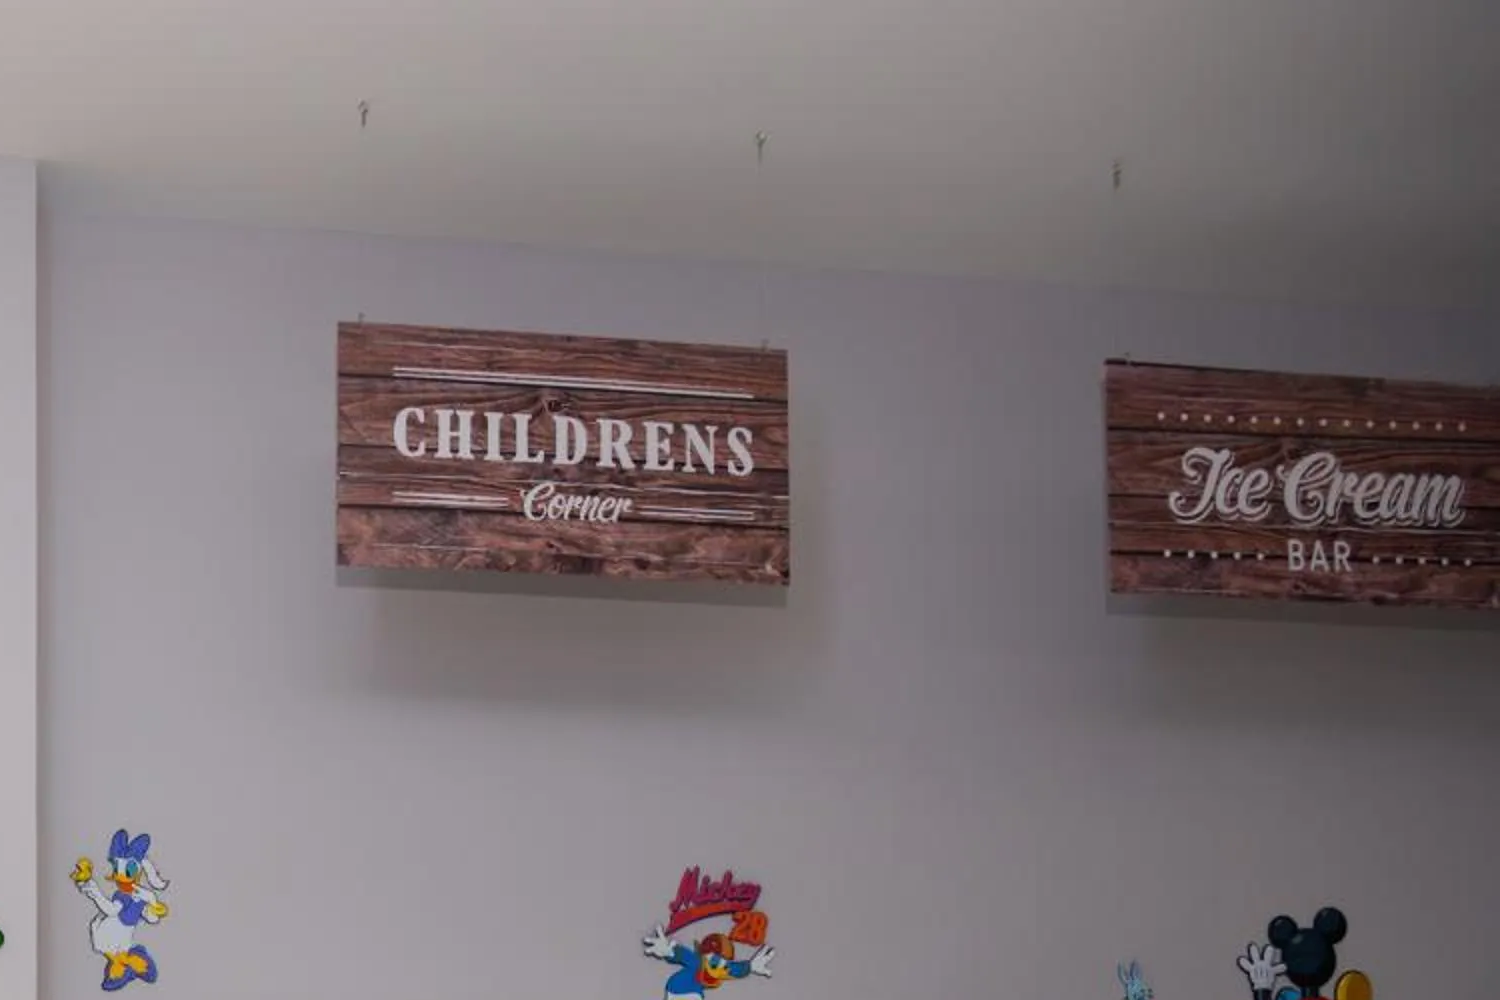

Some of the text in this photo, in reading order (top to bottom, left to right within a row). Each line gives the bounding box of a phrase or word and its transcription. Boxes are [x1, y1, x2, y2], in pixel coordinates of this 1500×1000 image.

[392, 406, 755, 478] CHILDRENS
[520, 481, 633, 523] Corner
[1168, 446, 1467, 529] Ice Cream
[1287, 538, 1353, 573] BAR
